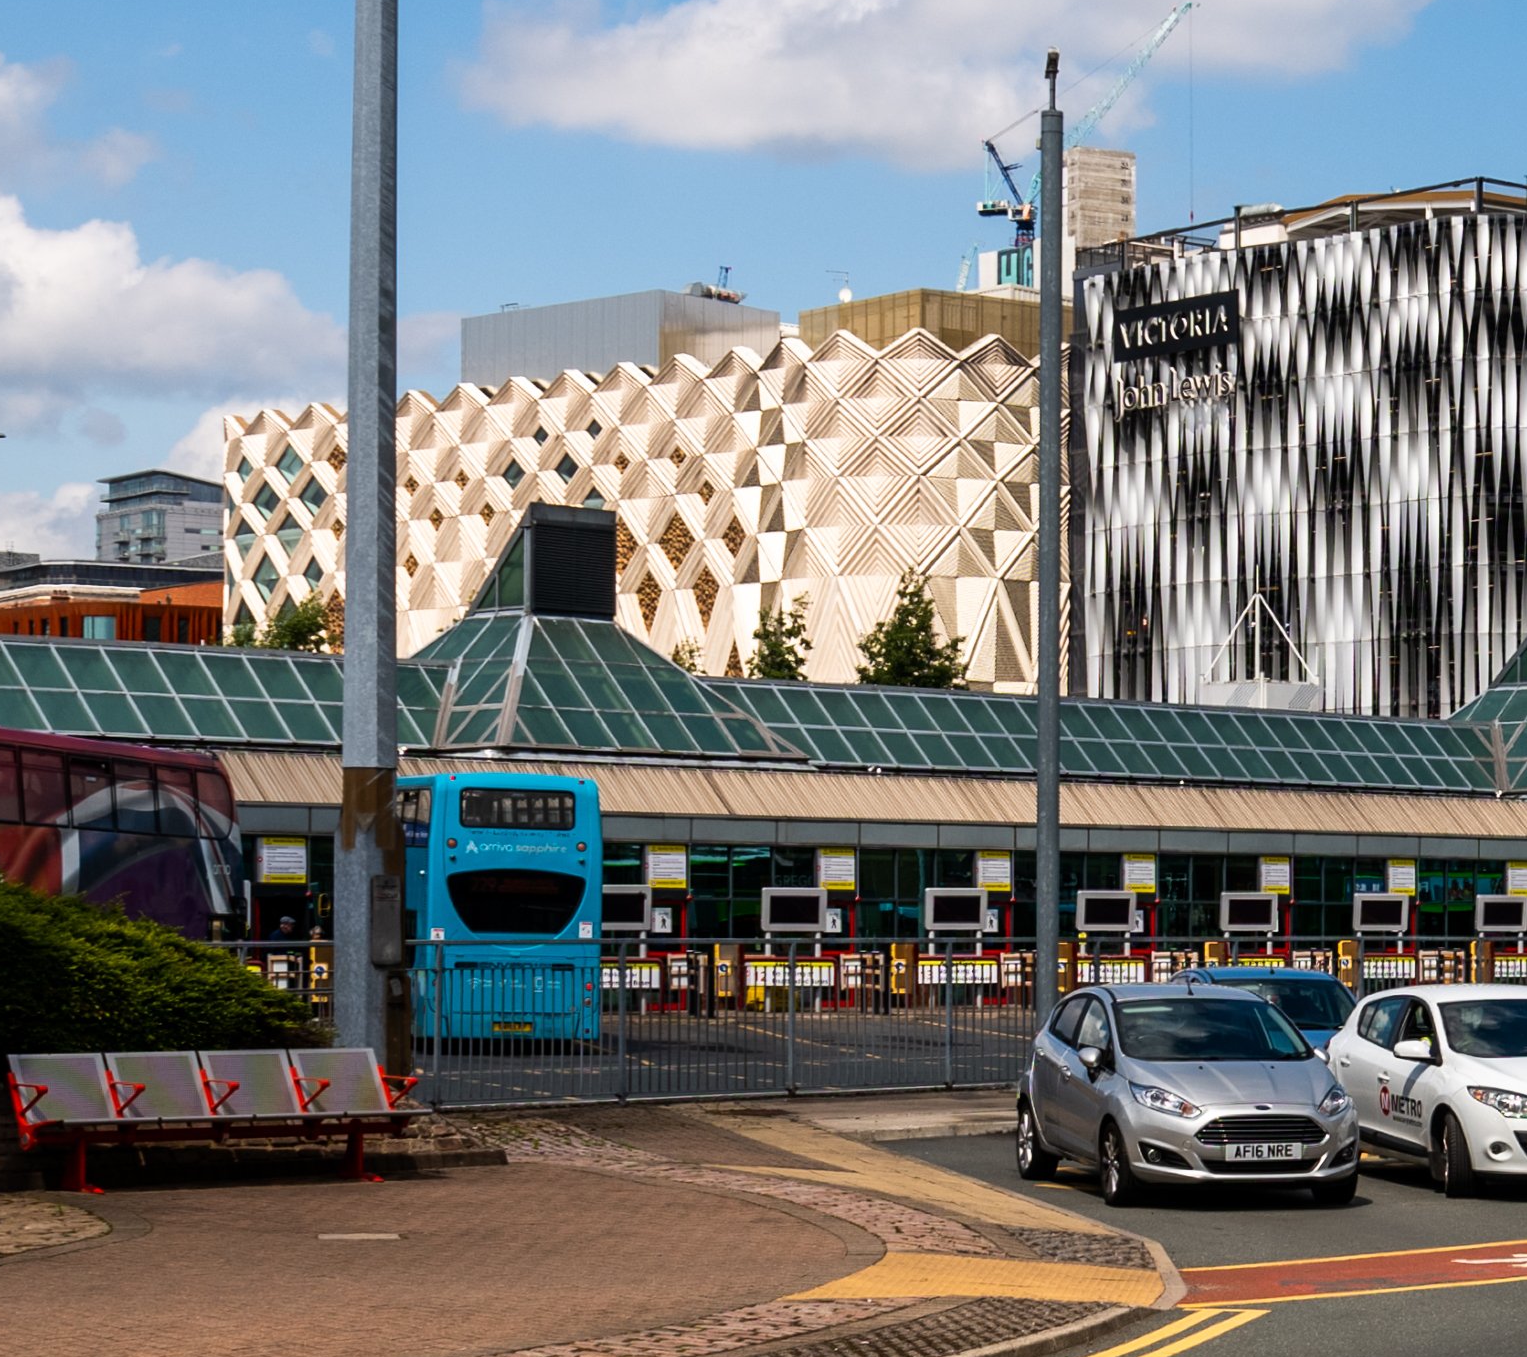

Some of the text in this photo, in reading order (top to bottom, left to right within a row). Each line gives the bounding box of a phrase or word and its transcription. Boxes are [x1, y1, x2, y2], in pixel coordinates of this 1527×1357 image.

[1120, 304, 1230, 349] VICTORIA
[1114, 362, 1235, 422] John Lewis
[479, 841, 568, 855] arriva sapphire
[1234, 1143, 1294, 1159] AF16 NRE
